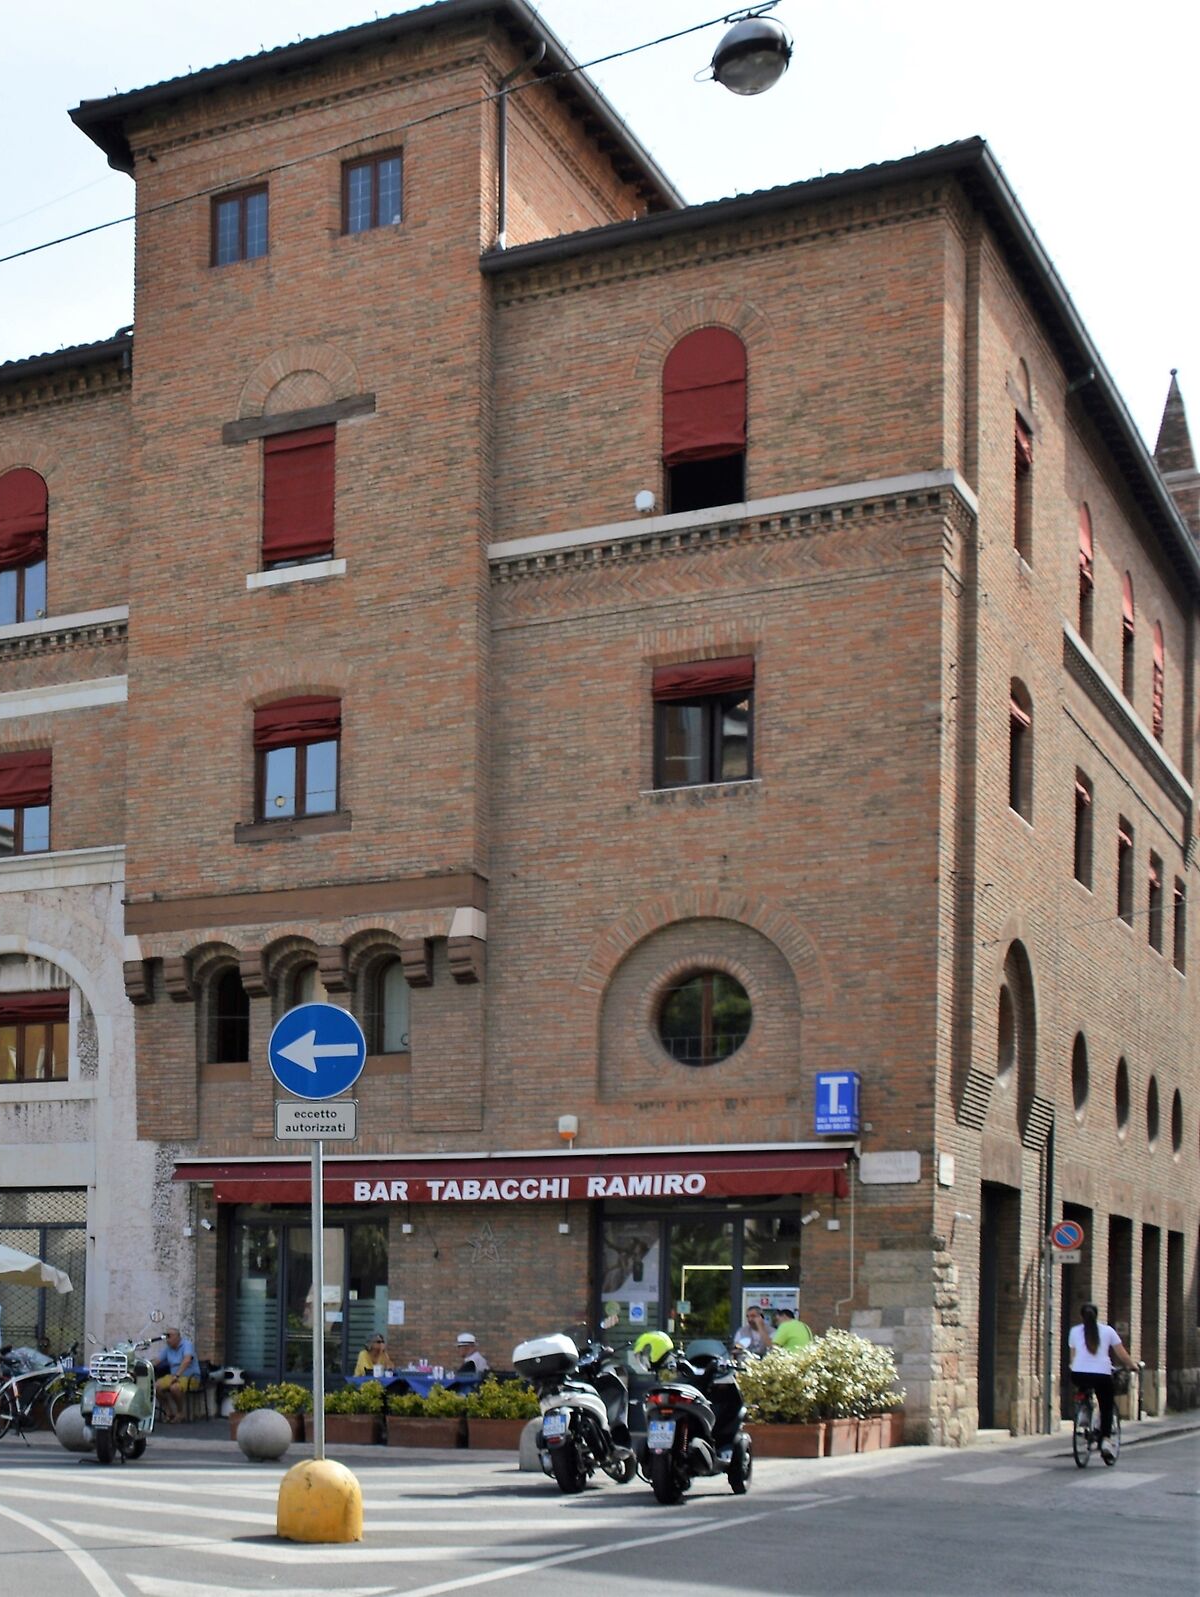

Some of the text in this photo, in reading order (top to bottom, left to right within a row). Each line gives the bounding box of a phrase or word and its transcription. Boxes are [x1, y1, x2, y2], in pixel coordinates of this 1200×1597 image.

[820, 1076, 849, 1115] T
[294, 1110, 337, 1119] eccetto
[285, 1123, 346, 1132] autorizzati
[354, 1173, 706, 1201] BAR TABACCHI RAMIRO
